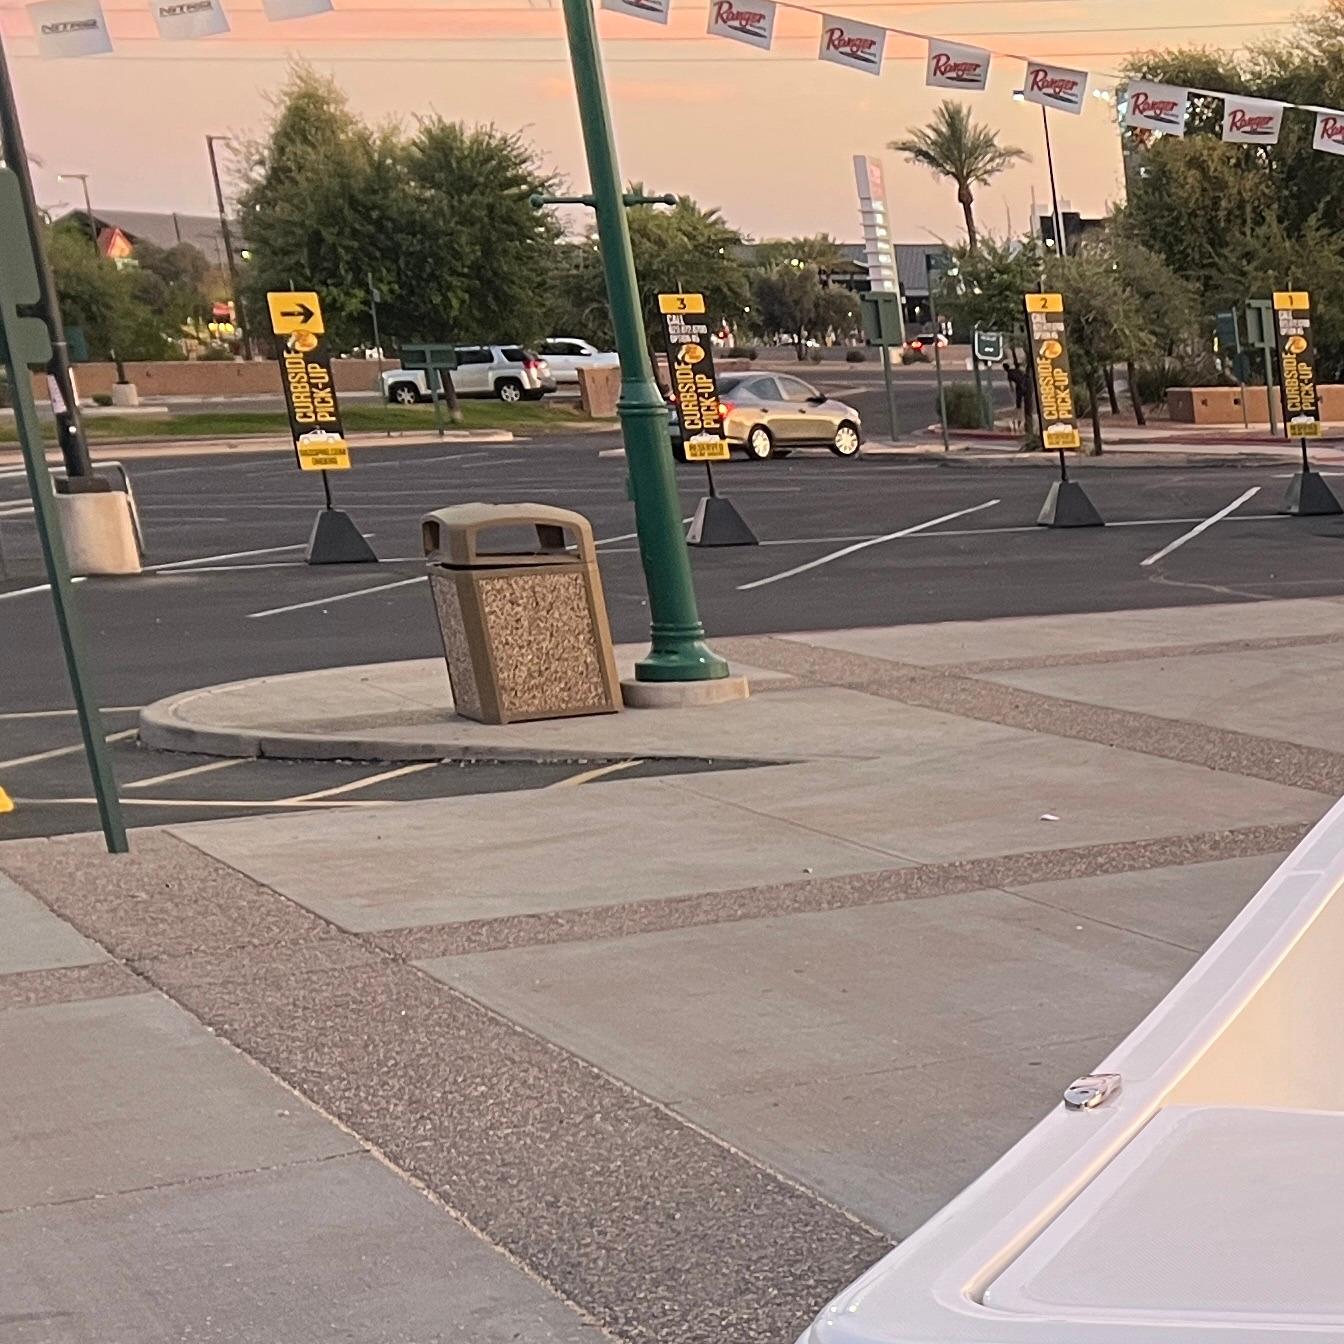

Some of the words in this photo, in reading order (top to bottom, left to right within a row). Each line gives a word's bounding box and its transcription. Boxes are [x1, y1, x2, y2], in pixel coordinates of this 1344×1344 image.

[714, 1, 766, 26] Ranger
[826, 27, 877, 53] Ranger
[932, 53, 982, 77] Ranger
[1030, 69, 1079, 94] Ranger
[1131, 92, 1178, 116] Ranger
[1228, 109, 1274, 132] Ranger
[676, 297, 687, 310] 3
[1040, 298, 1048, 309] 2
[1288, 295, 1294, 306] 1
[284, 350, 315, 423] CURBSIDE
[308, 363, 337, 422] PICK-UP
[674, 360, 702, 430] CURBSIDE
[1037, 356, 1058, 420] CURBSIDE
[1053, 368, 1073, 418] PICK-UP
[1282, 353, 1301, 411] CURBSIDE
[1298, 362, 1316, 410] PICK-UP
[695, 374, 720, 429] PICK-UP
